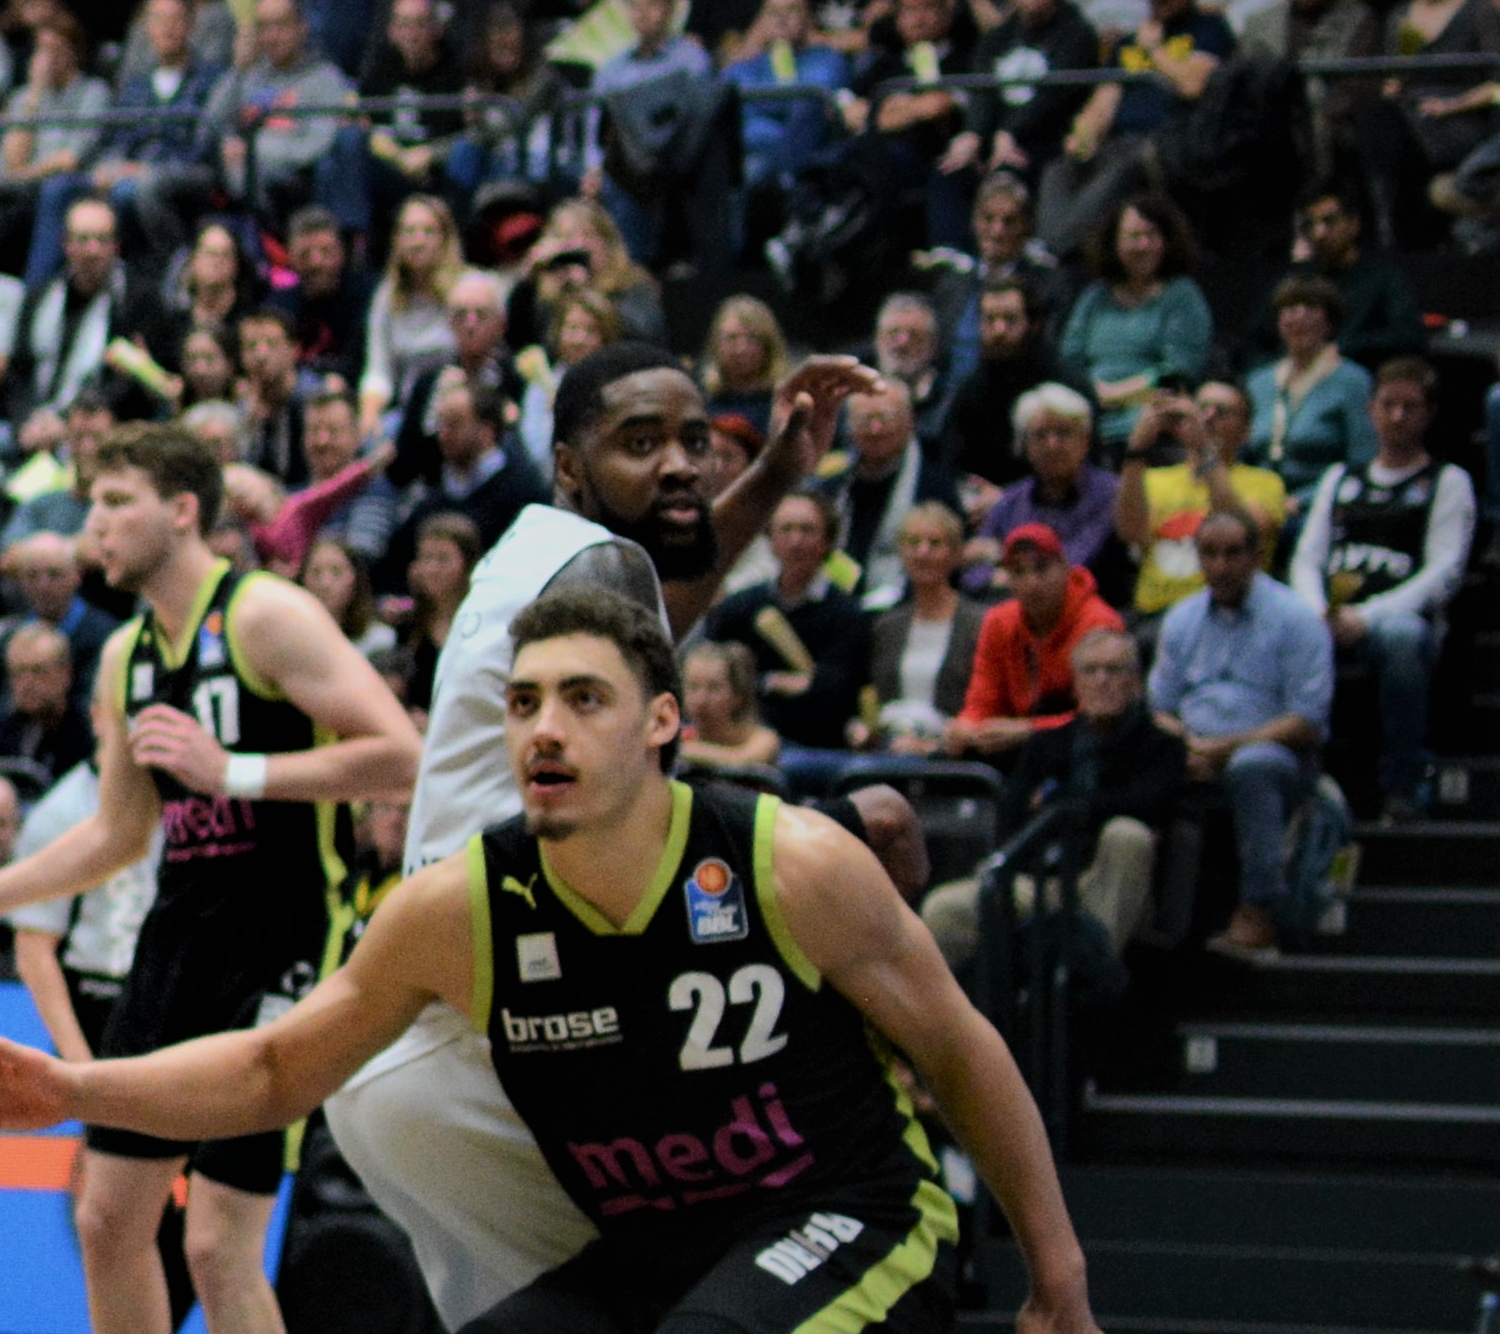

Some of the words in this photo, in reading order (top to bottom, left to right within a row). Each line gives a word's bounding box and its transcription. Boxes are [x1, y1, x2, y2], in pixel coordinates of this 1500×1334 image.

[501, 1005, 620, 1043] brose
[668, 962, 790, 1072] 22
[566, 1081, 805, 1189] medi
